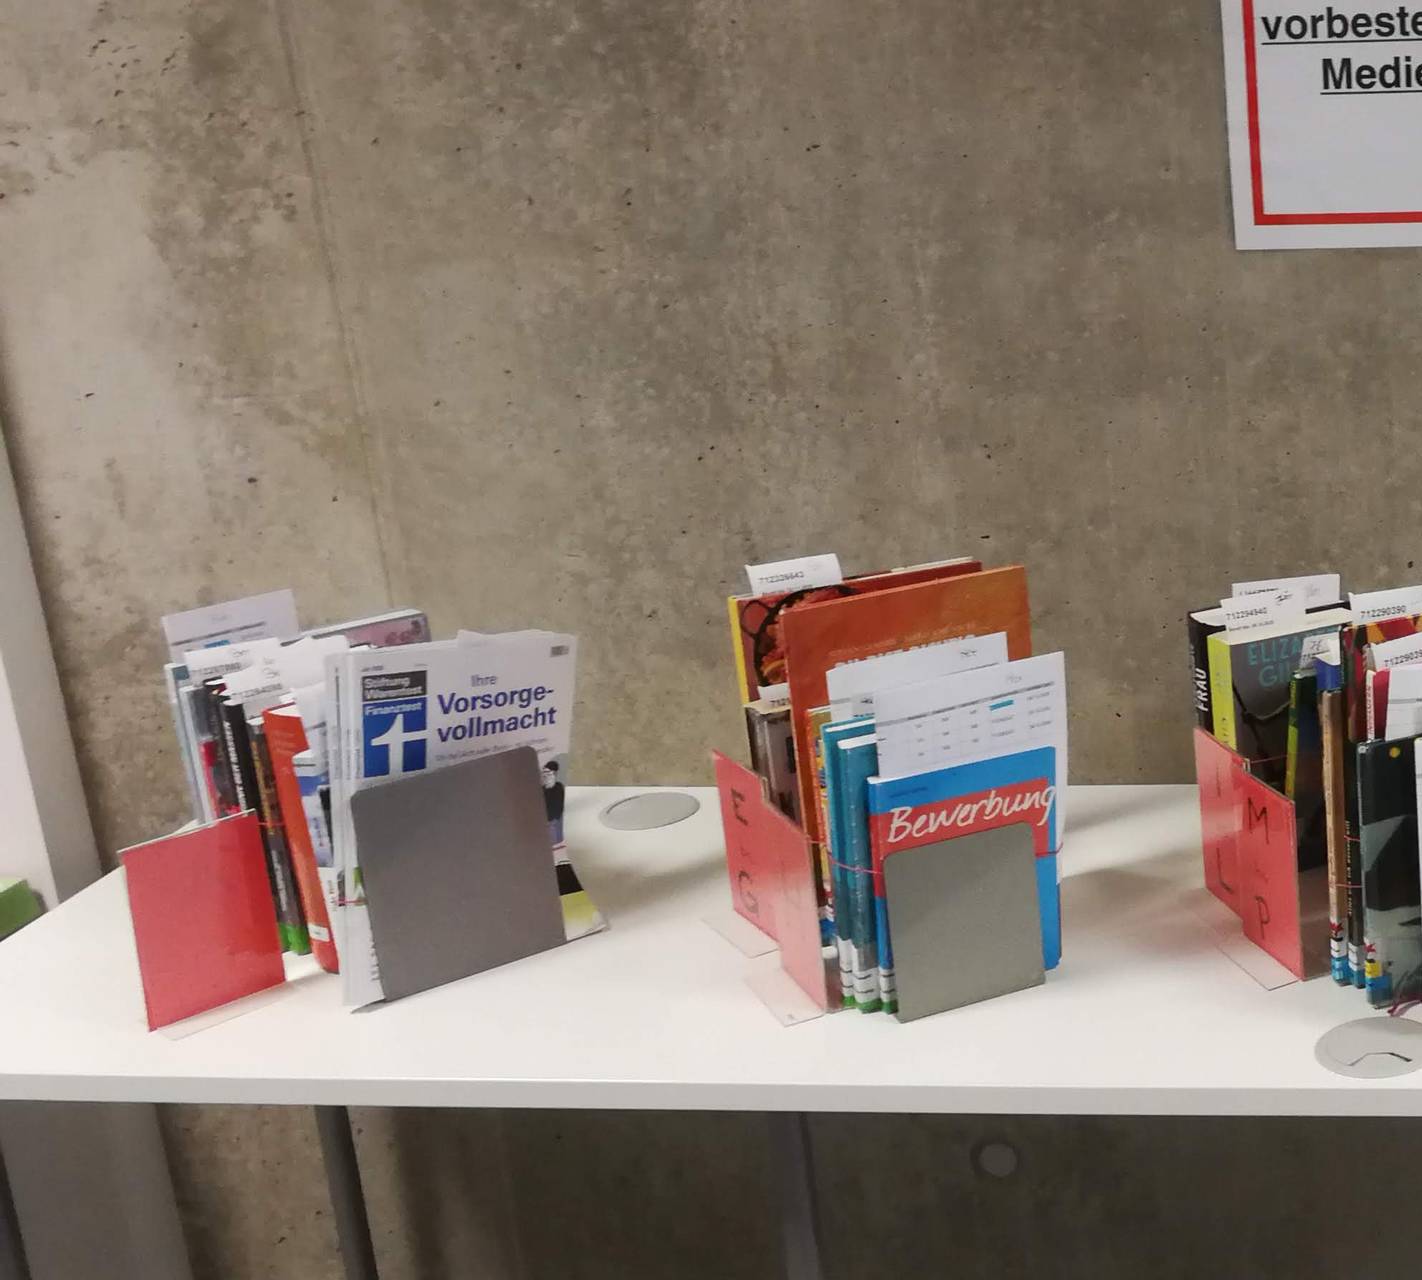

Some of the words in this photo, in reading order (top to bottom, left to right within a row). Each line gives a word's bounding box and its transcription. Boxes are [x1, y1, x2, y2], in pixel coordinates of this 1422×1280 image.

[438, 685, 555, 715] Vorsorge-
[471, 674, 498, 687] Ihre
[1195, 667, 1209, 713] FRAU
[437, 707, 557, 742] vollmacht
[730, 788, 749, 827] E
[887, 785, 1058, 843] Bewerbung
[1247, 797, 1270, 845] M
[737, 869, 760, 917] G
[1216, 847, 1235, 896] L
[1255, 896, 1272, 940] P
